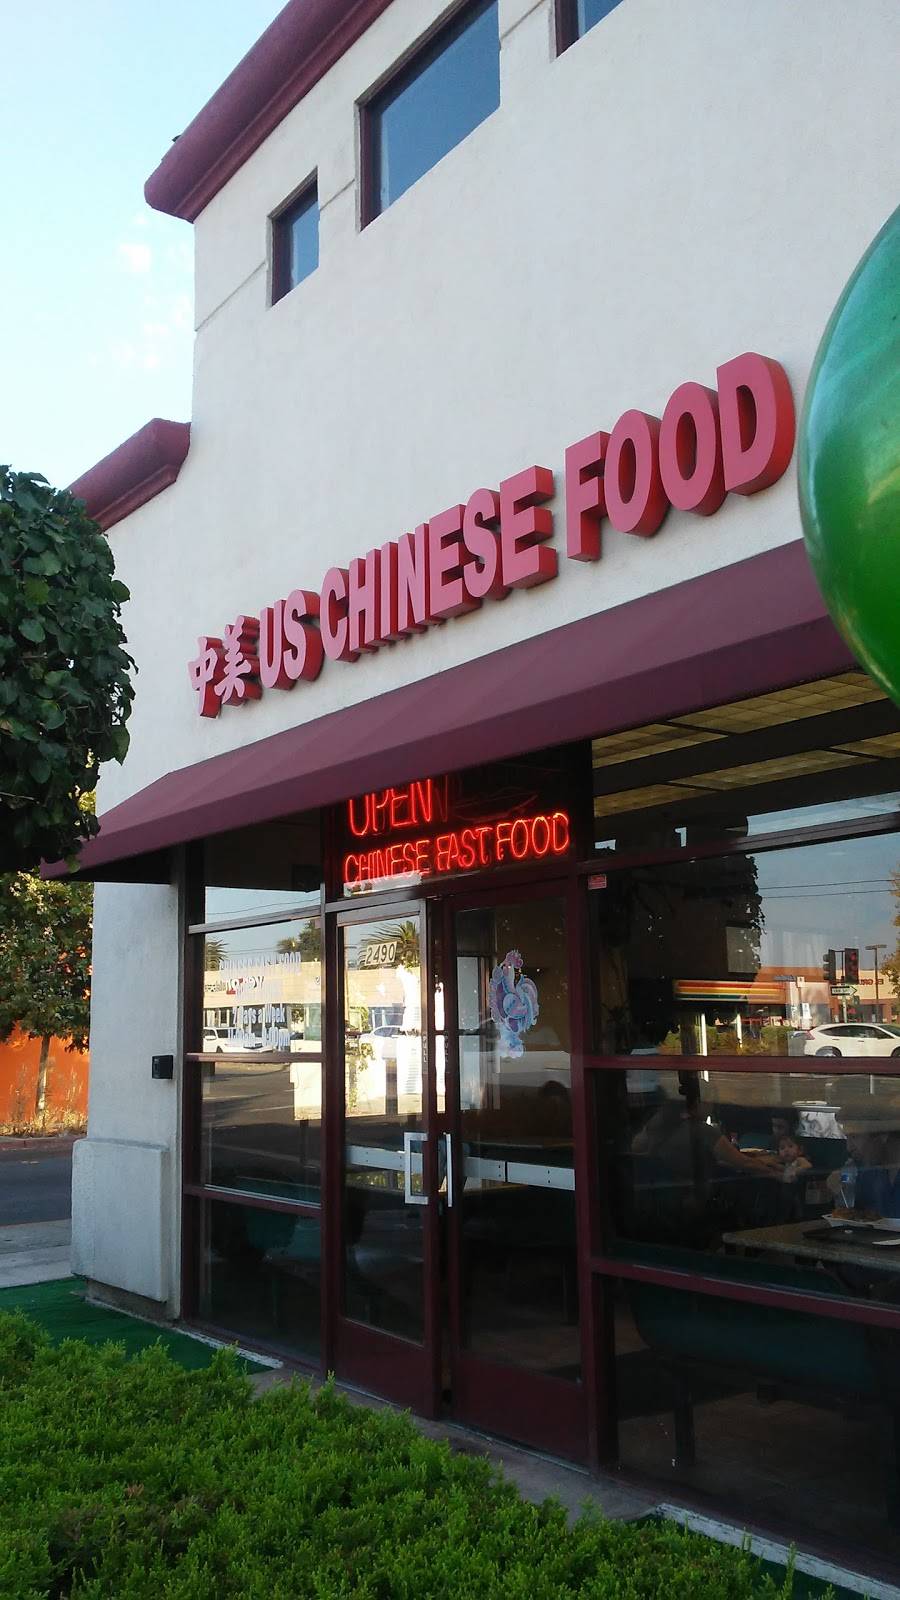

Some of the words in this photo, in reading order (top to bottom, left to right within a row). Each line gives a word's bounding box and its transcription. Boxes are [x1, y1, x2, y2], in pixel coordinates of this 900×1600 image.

[259, 588, 324, 690] US
[319, 465, 558, 662] CHINESE
[565, 351, 796, 561] FOOD
[348, 778, 432, 836] OPEN
[344, 838, 432, 886] CHINESE
[496, 811, 570, 862] FOOD
[365, 943, 396, 965] 2490
